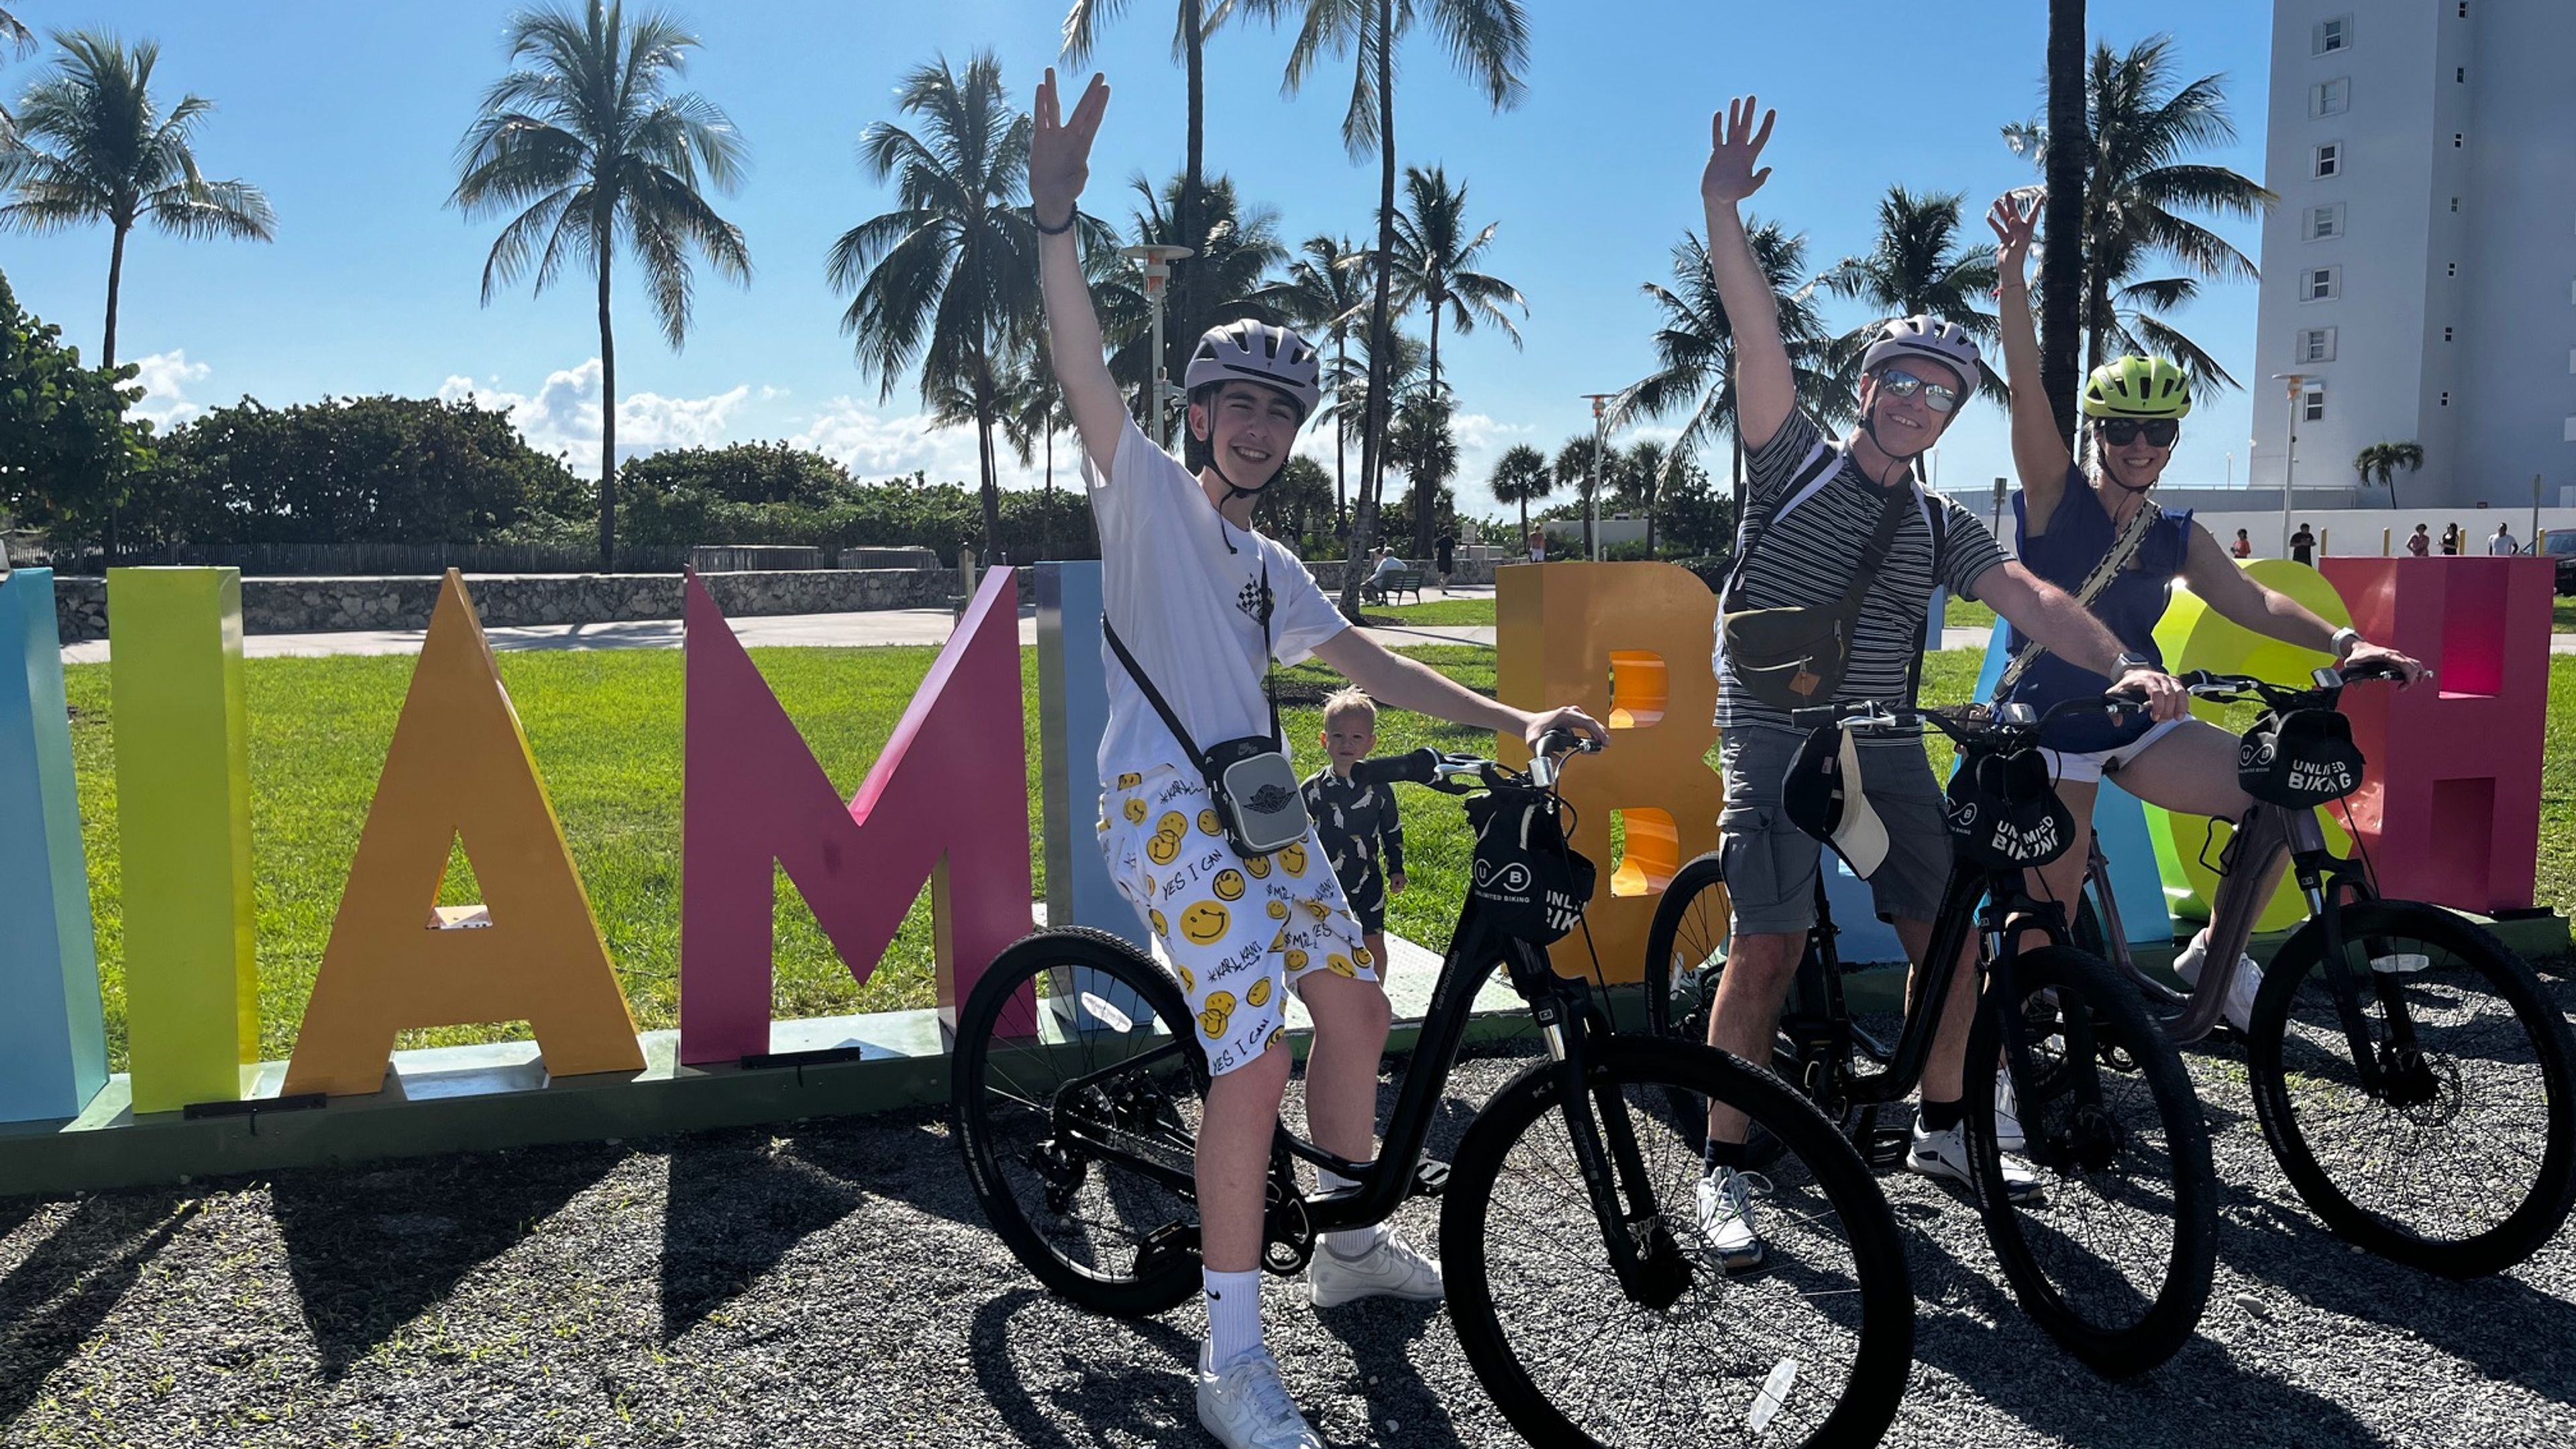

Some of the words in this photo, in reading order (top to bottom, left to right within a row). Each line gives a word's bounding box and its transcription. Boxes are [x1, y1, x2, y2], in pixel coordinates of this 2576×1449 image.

[1162, 871, 1186, 901] YES
[1187, 863, 1199, 881] I
[1201, 849, 1223, 871] CAN
[1479, 866, 1487, 879] U
[1509, 871, 1522, 883] B
[1503, 895, 1531, 904] BIKING
[1434, 950, 1460, 1011] cannondale
[1212, 1049, 1234, 1075] YES
[1234, 1038, 1247, 1057] I
